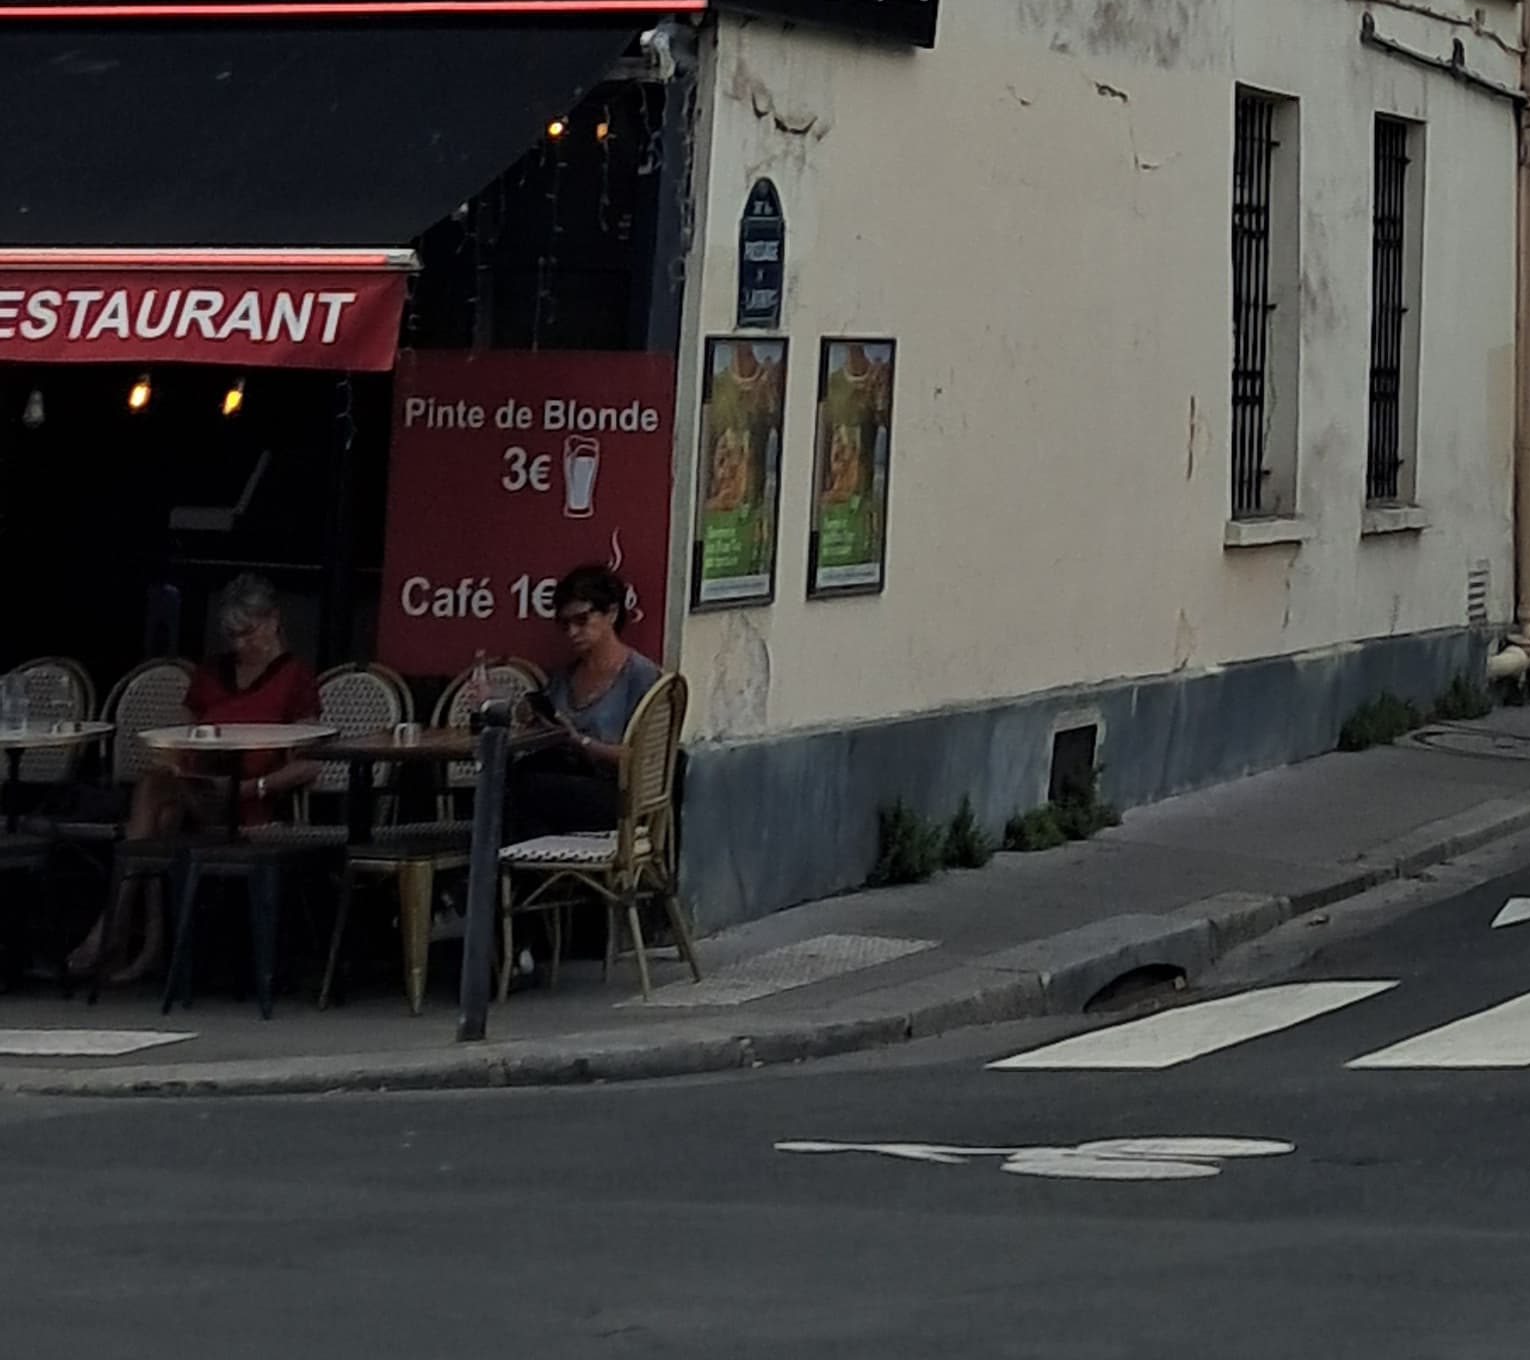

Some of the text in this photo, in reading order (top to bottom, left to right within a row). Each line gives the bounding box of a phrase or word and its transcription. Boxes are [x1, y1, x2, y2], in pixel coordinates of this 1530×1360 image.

[404, 397, 658, 431] Pinte de Blonde
[502, 446, 551, 492] 3€
[401, 573, 557, 619] Café 1€
